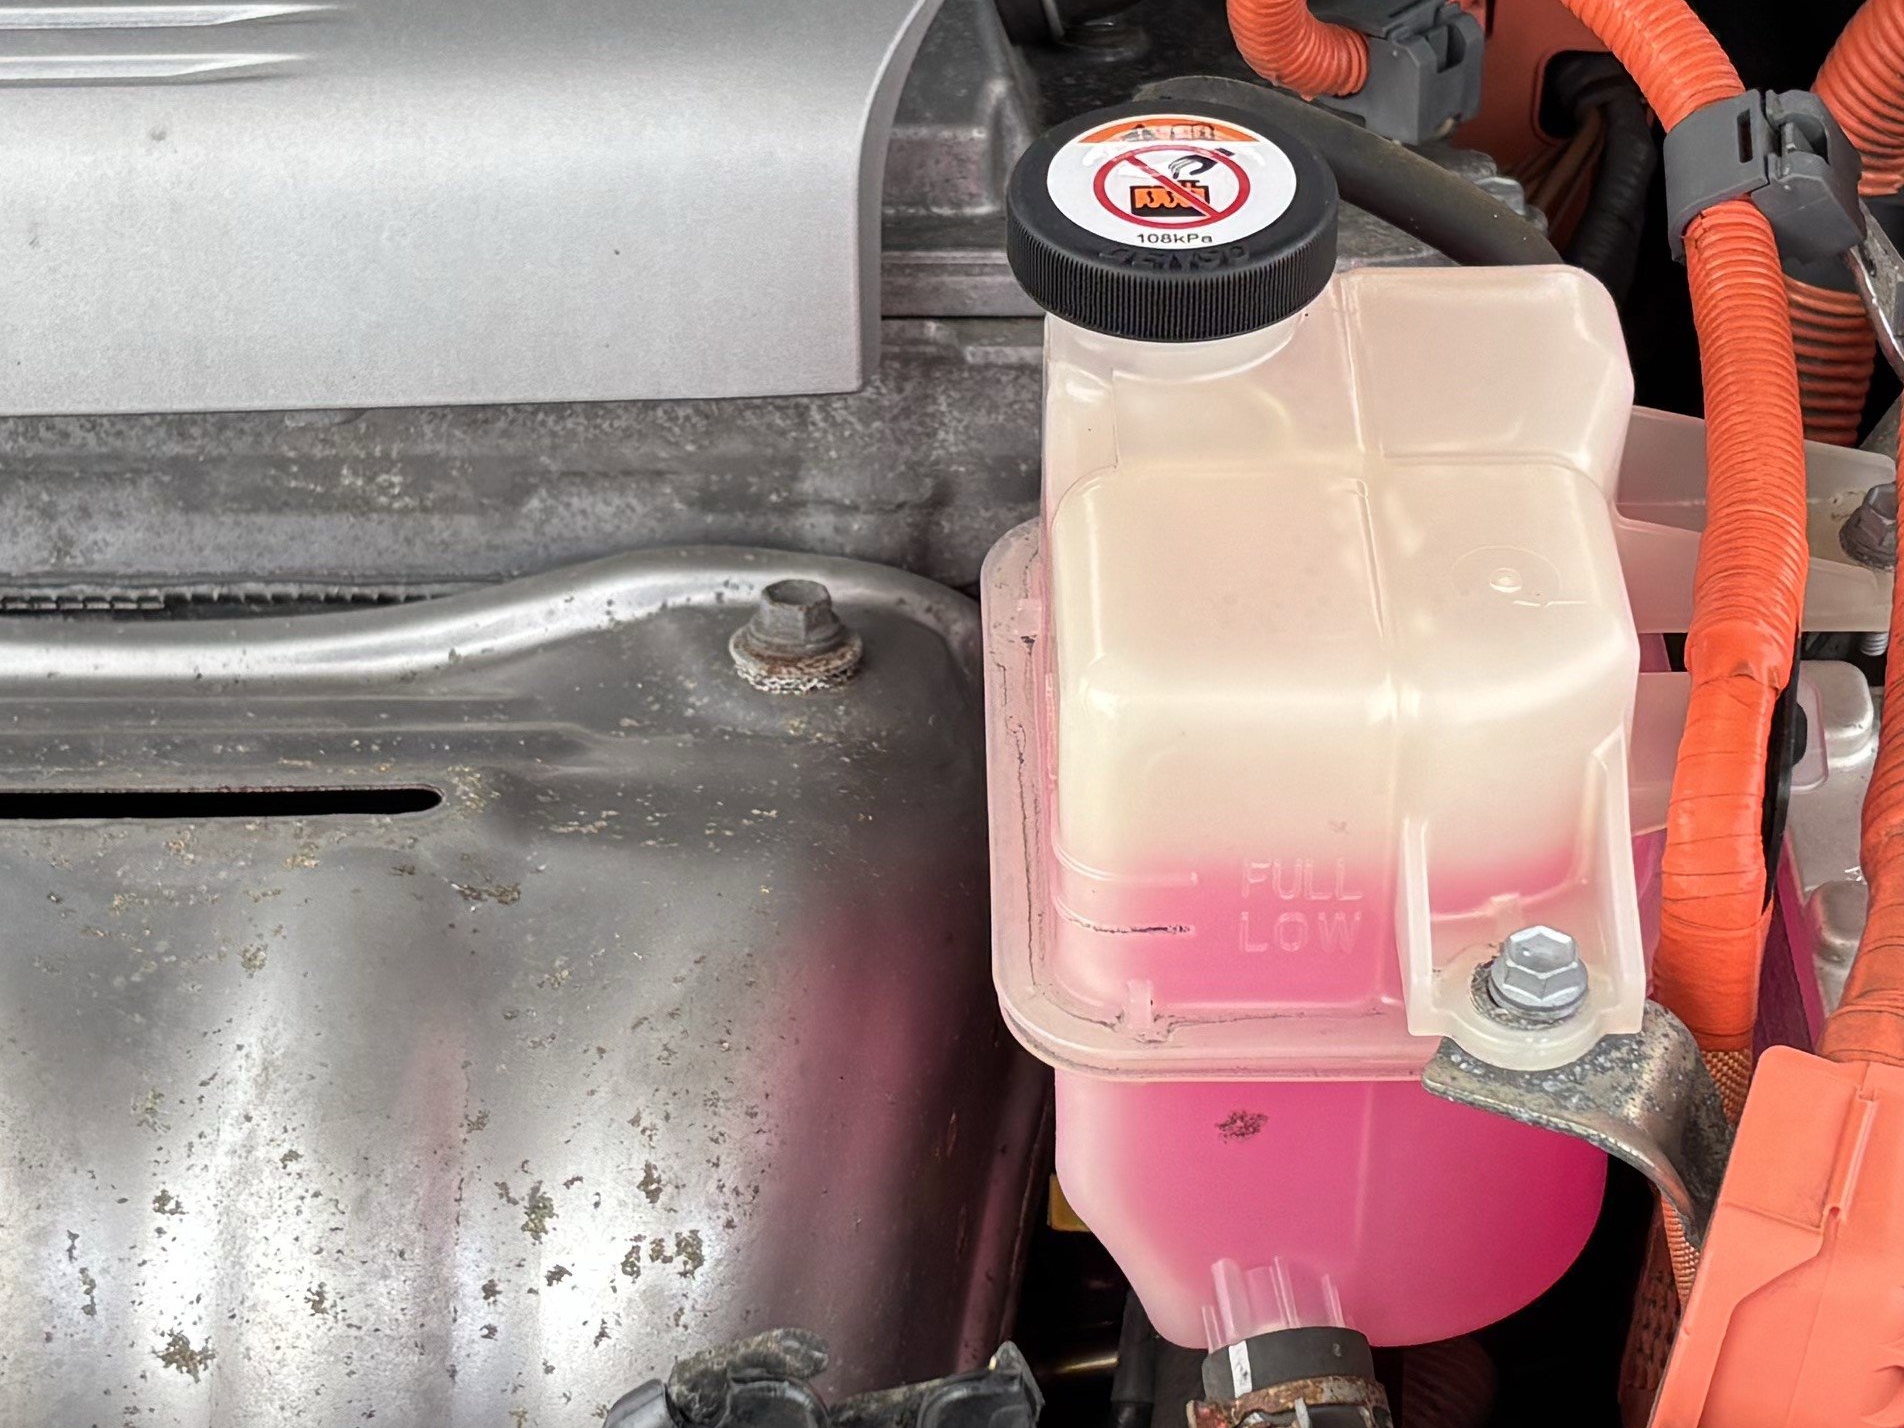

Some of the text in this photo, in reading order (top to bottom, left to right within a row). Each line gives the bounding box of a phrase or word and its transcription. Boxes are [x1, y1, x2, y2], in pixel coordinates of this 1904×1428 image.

[1137, 233, 1213, 244] 108kPa
[1239, 857, 1364, 901] FULL
[1236, 910, 1363, 954] LOW
